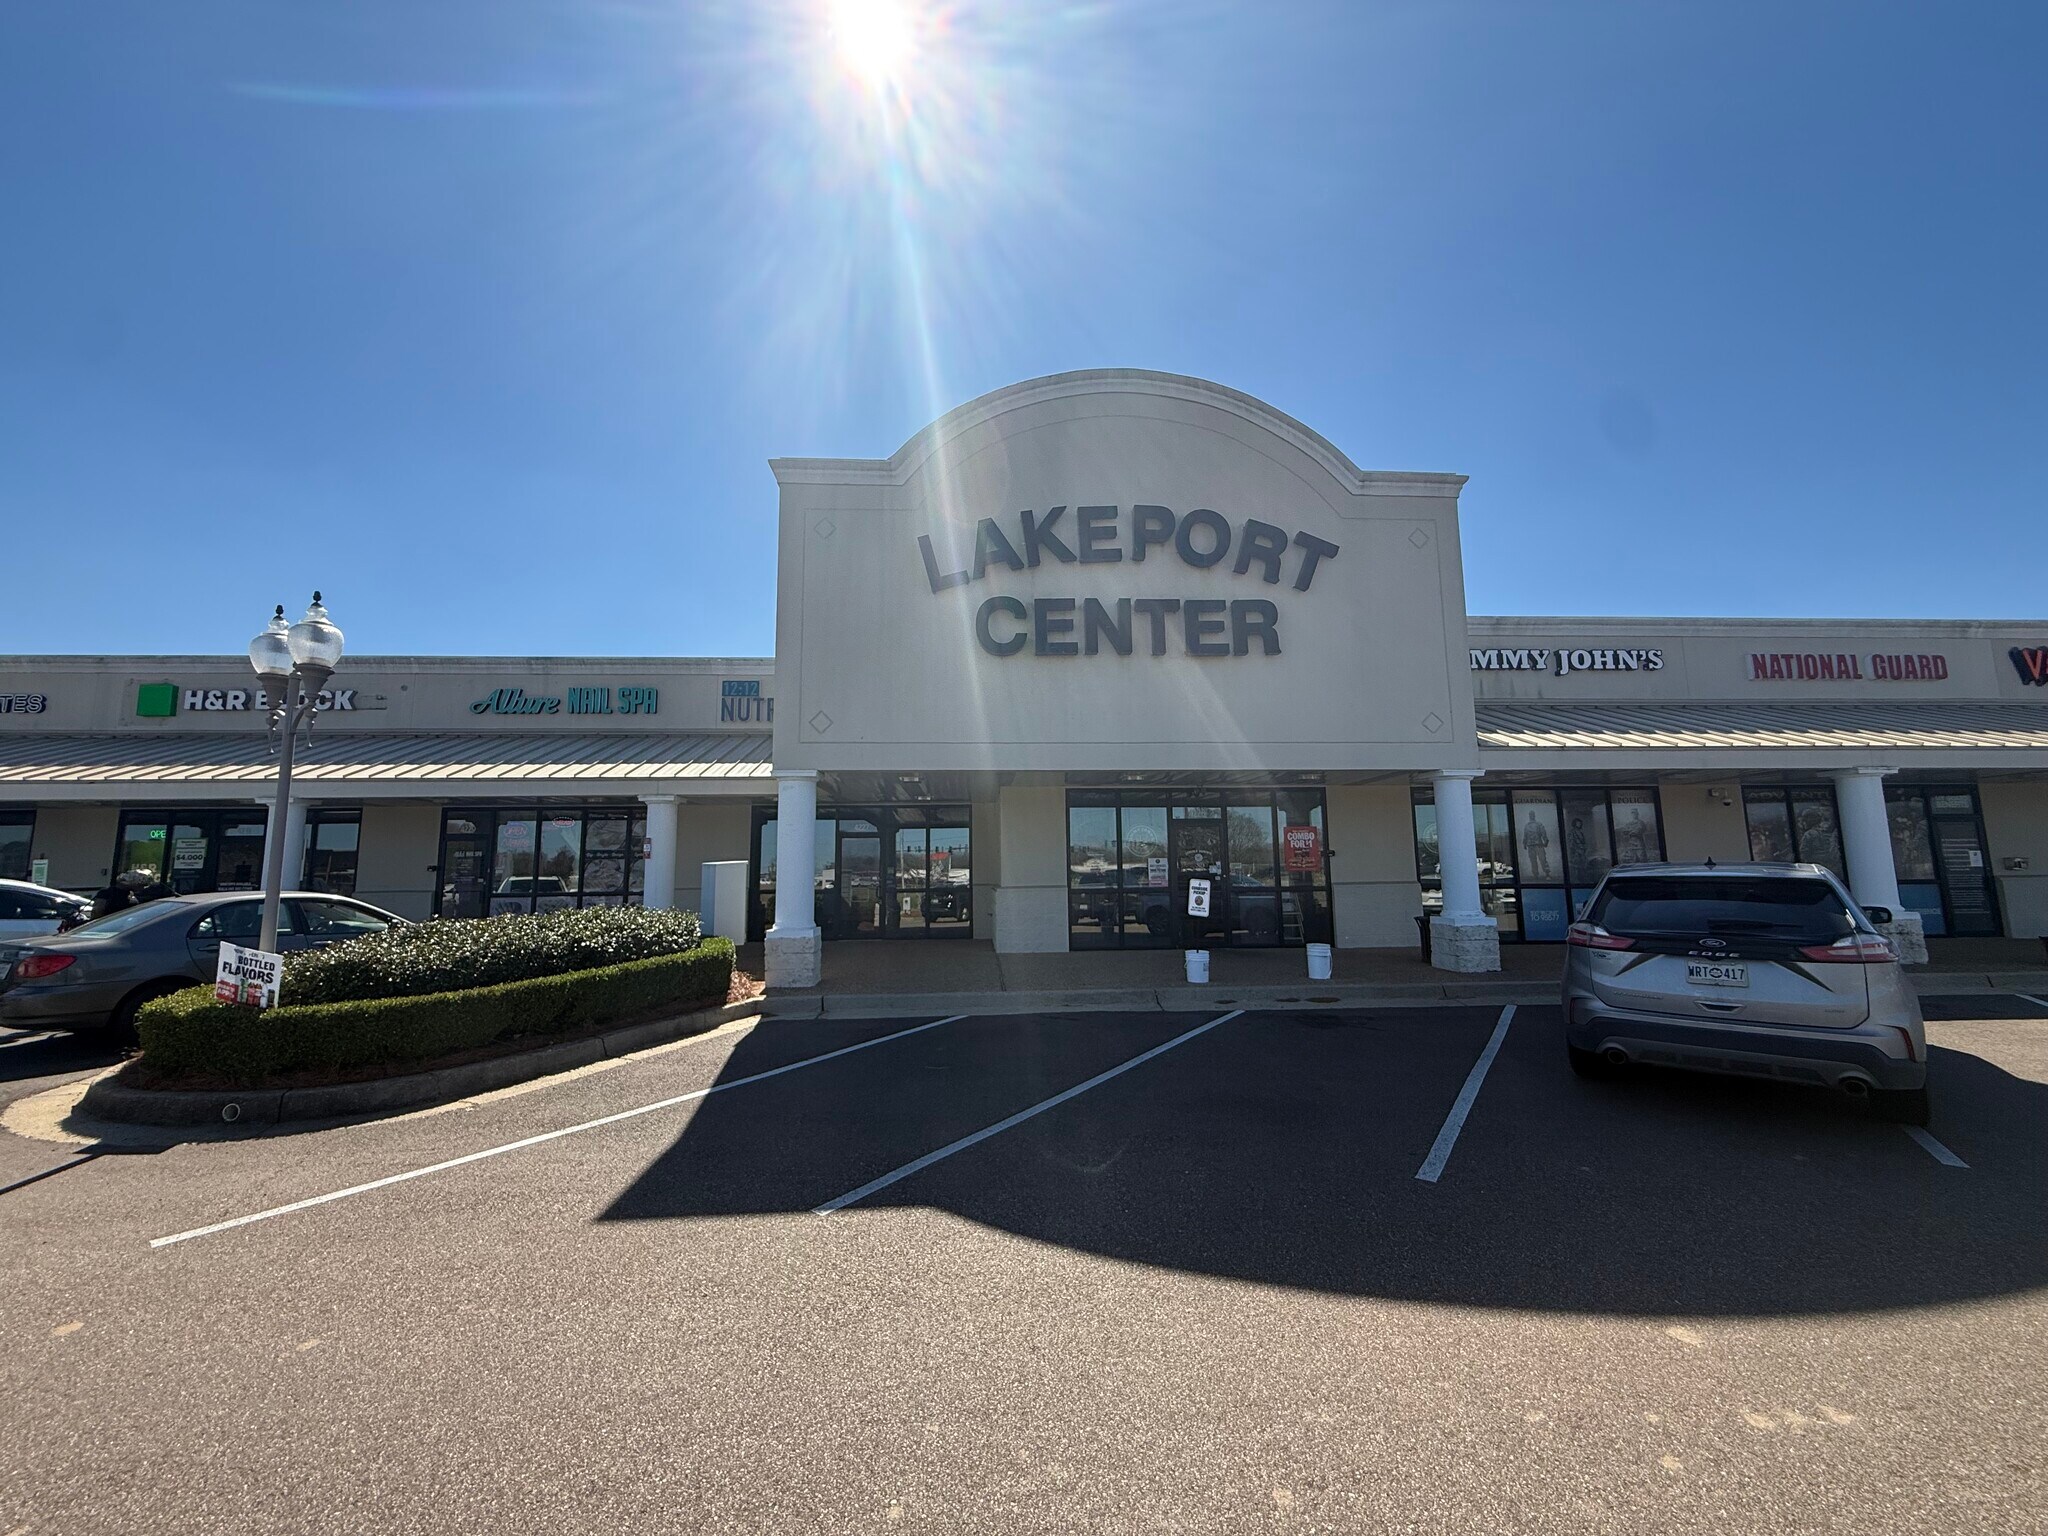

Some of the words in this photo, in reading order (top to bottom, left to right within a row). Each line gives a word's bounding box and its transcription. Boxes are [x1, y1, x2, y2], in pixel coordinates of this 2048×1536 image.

[917, 505, 1340, 594] LAKEPORT
[976, 595, 1282, 656] CENTER
[1470, 650, 1549, 670] MMY
[1556, 649, 1664, 675] JOHN'S
[1750, 653, 1863, 680] NATIONAL
[1870, 653, 1949, 681] GUARD
[722, 681, 759, 696] 12:12
[0, 693, 45, 713] TES
[183, 690, 247, 711] H&R
[254, 690, 355, 711] BCK
[469, 687, 561, 715] Allure
[567, 686, 613, 715] NAIL
[617, 686, 659, 715] SPA
[1287, 832, 1315, 841] COMBO
[1290, 840, 1305, 848] FOR
[222, 961, 275, 984] FLAVORS
[238, 955, 275, 971] BOTTLED
[1688, 965, 1708, 978] WRT
[1723, 968, 1745, 980] 417
